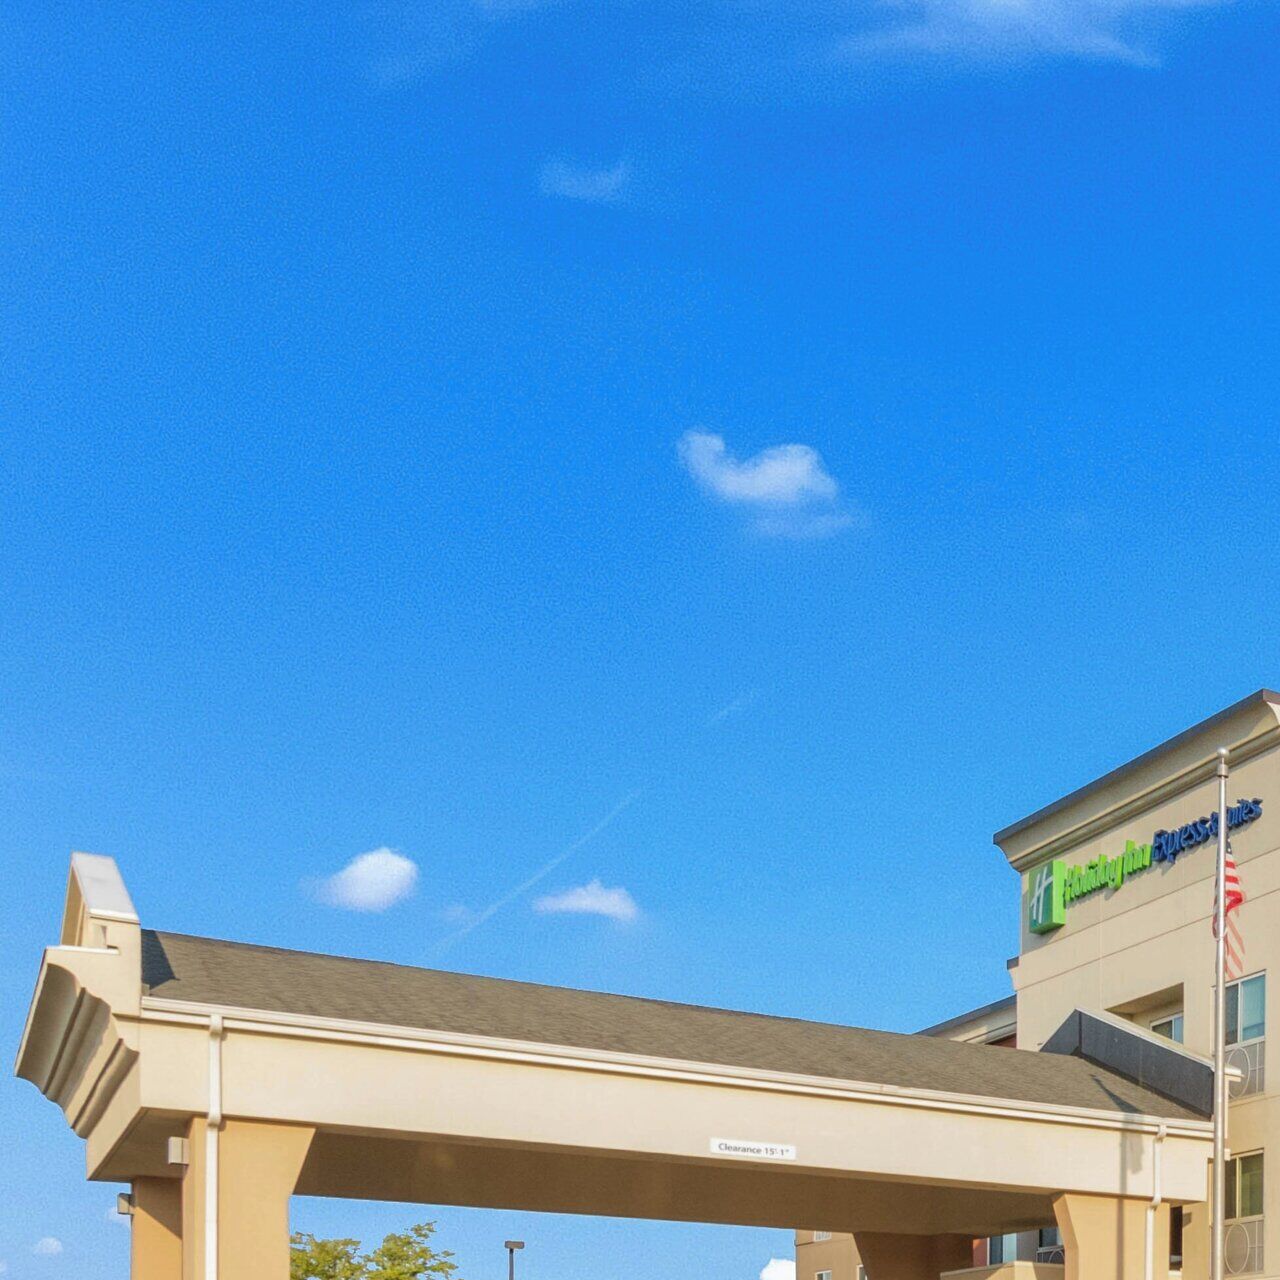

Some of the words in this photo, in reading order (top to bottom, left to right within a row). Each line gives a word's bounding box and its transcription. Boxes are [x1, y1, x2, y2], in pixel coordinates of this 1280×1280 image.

[1063, 853, 1124, 903] Holiday
[1122, 840, 1152, 874] Inn
[1152, 815, 1210, 864] Express
[1222, 798, 1263, 830] uites
[718, 1142, 762, 1154] Clearance
